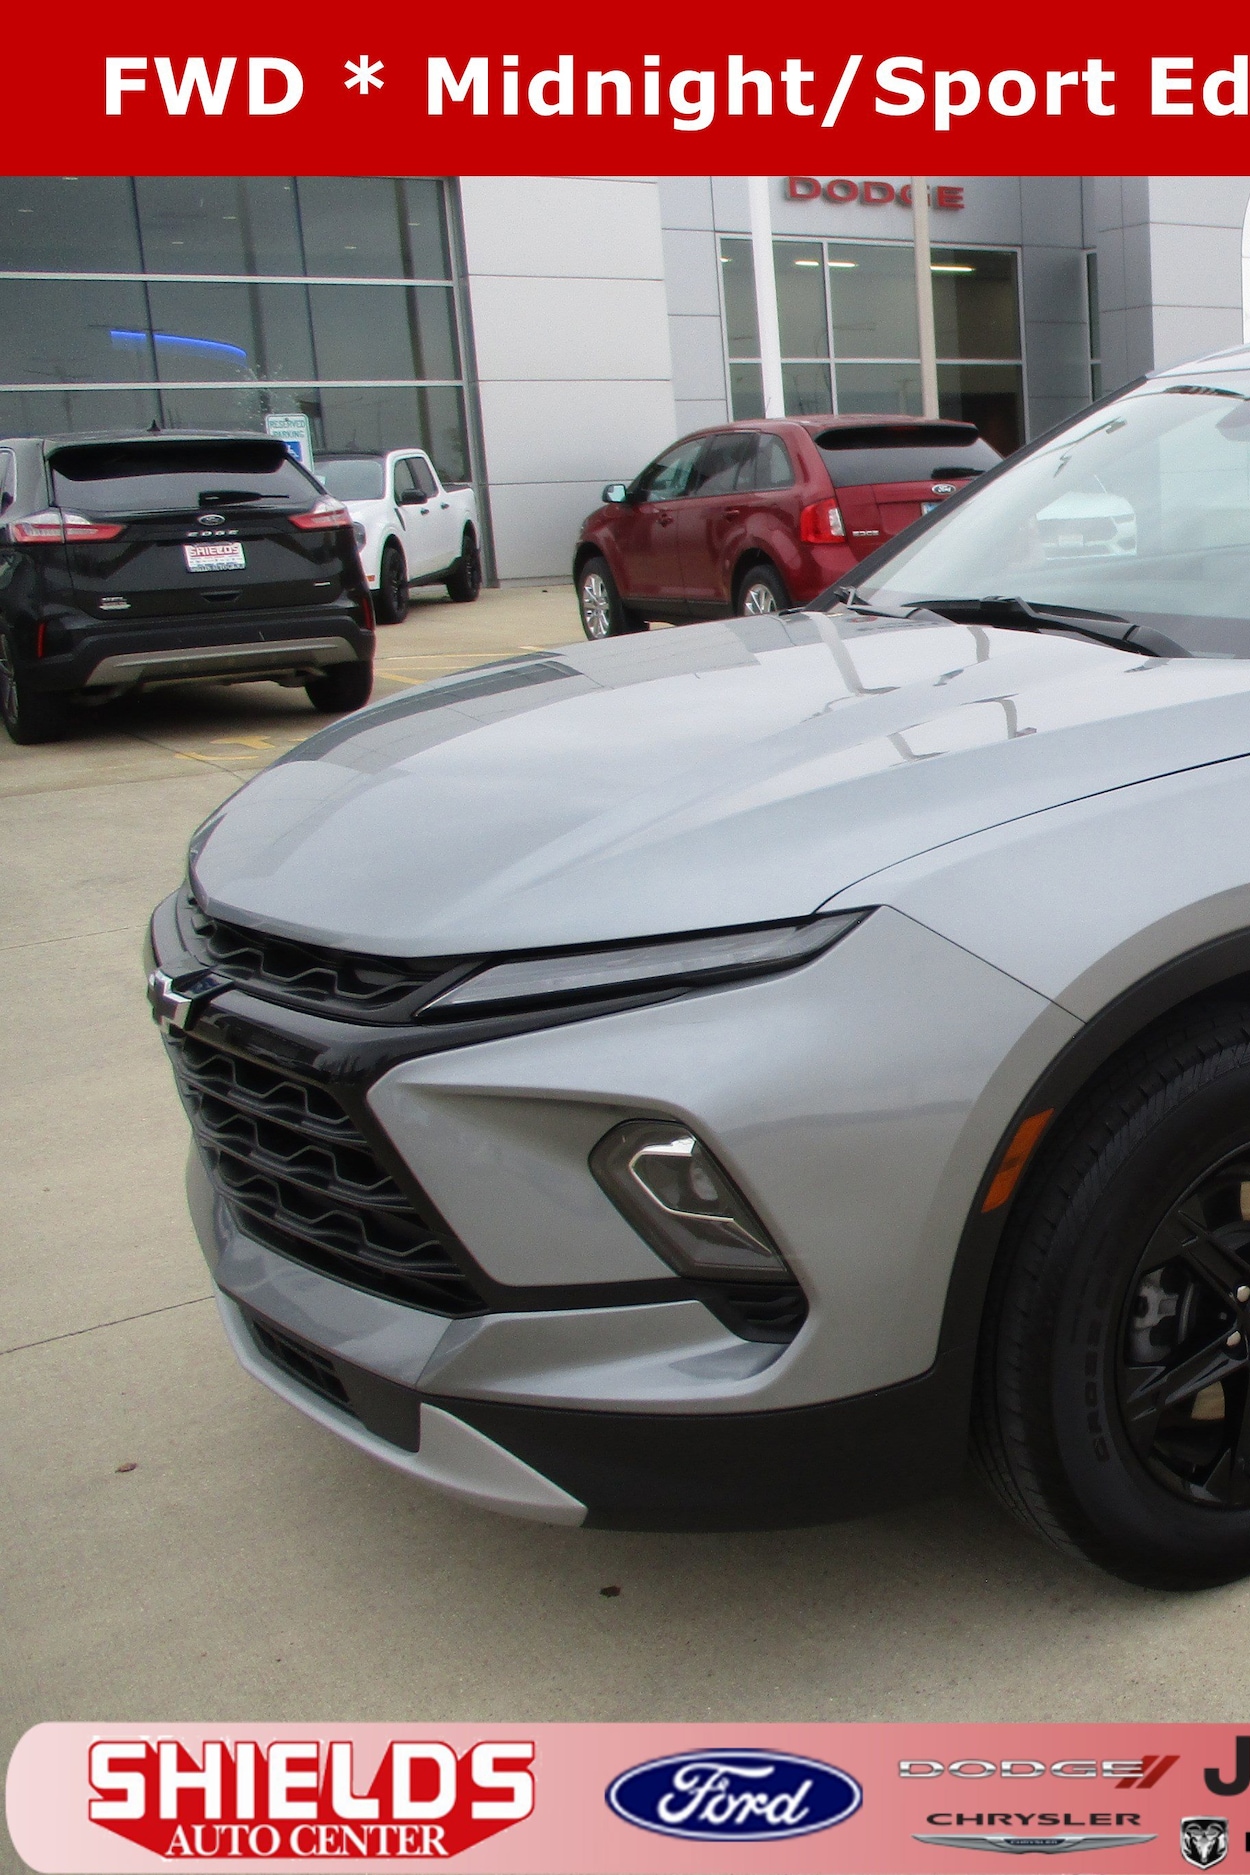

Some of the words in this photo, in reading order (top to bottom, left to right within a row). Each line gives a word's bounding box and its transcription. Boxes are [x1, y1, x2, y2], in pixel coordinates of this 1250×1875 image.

[268, 420, 306, 428] RESERVED
[187, 530, 239, 538] EDGE
[189, 545, 239, 556] SHIELDS
